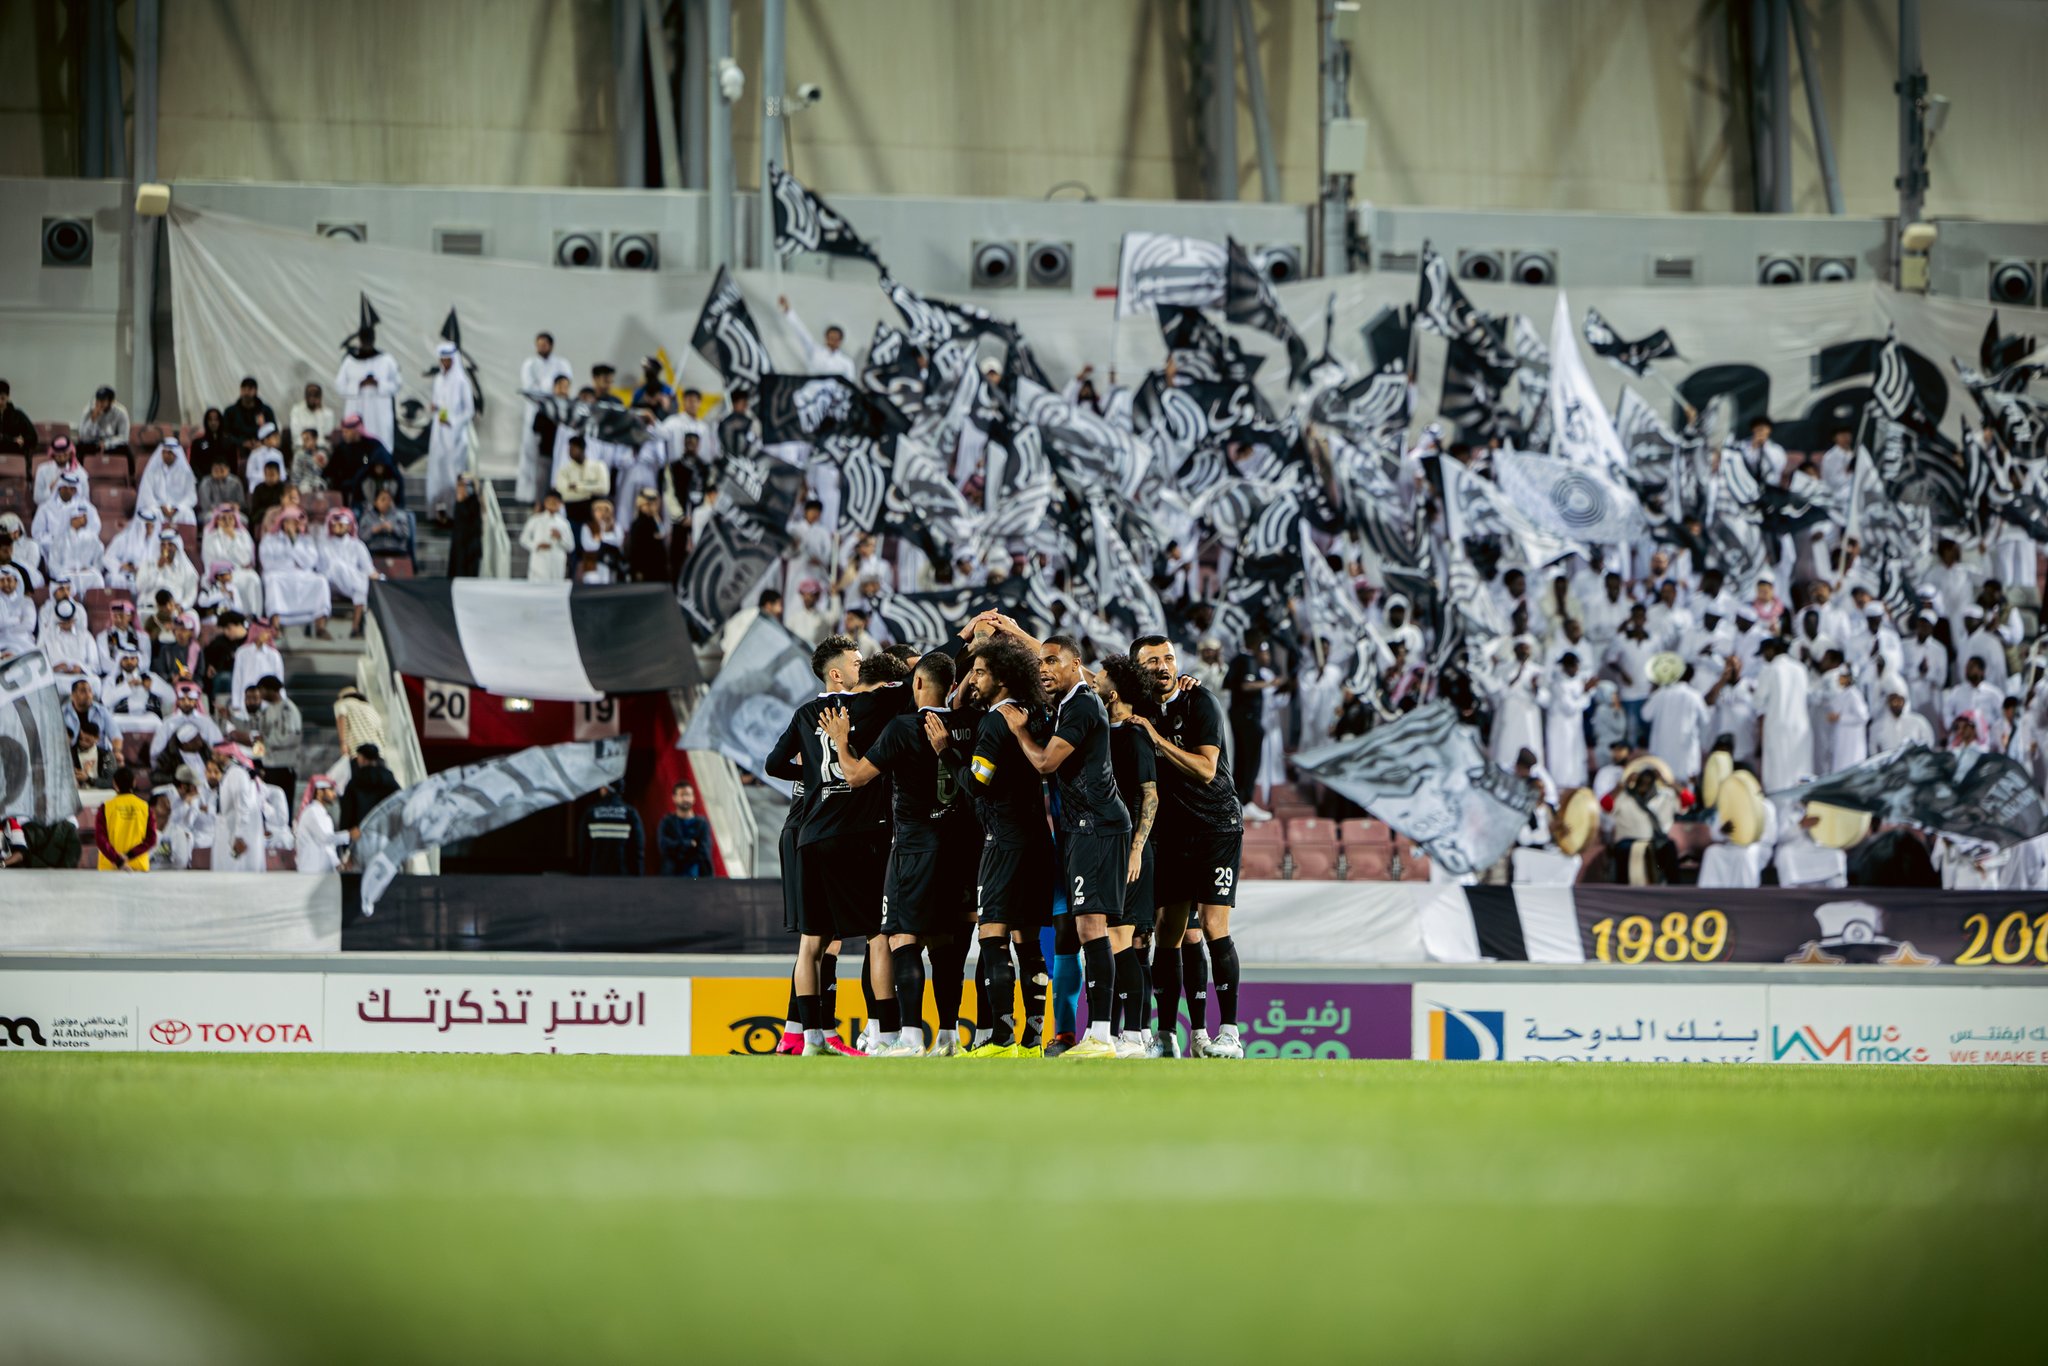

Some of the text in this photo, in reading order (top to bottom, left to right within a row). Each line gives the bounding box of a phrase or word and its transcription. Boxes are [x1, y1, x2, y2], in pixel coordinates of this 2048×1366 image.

[427, 691, 466, 720] 20
[578, 700, 615, 722] 19
[1074, 875, 1085, 897] 2
[1214, 866, 1234, 887] 29
[1591, 909, 1729, 965] 1989
[52, 1028, 129, 1040] Al Abdulghani
[52, 1039, 90, 1048] Motors
[199, 1023, 313, 1043] TOYOTA
[1524, 1018, 1760, 1051] بنك الدوحة
[1950, 1050, 1979, 1063] WE
[1983, 1050, 2037, 1063] MAKE
